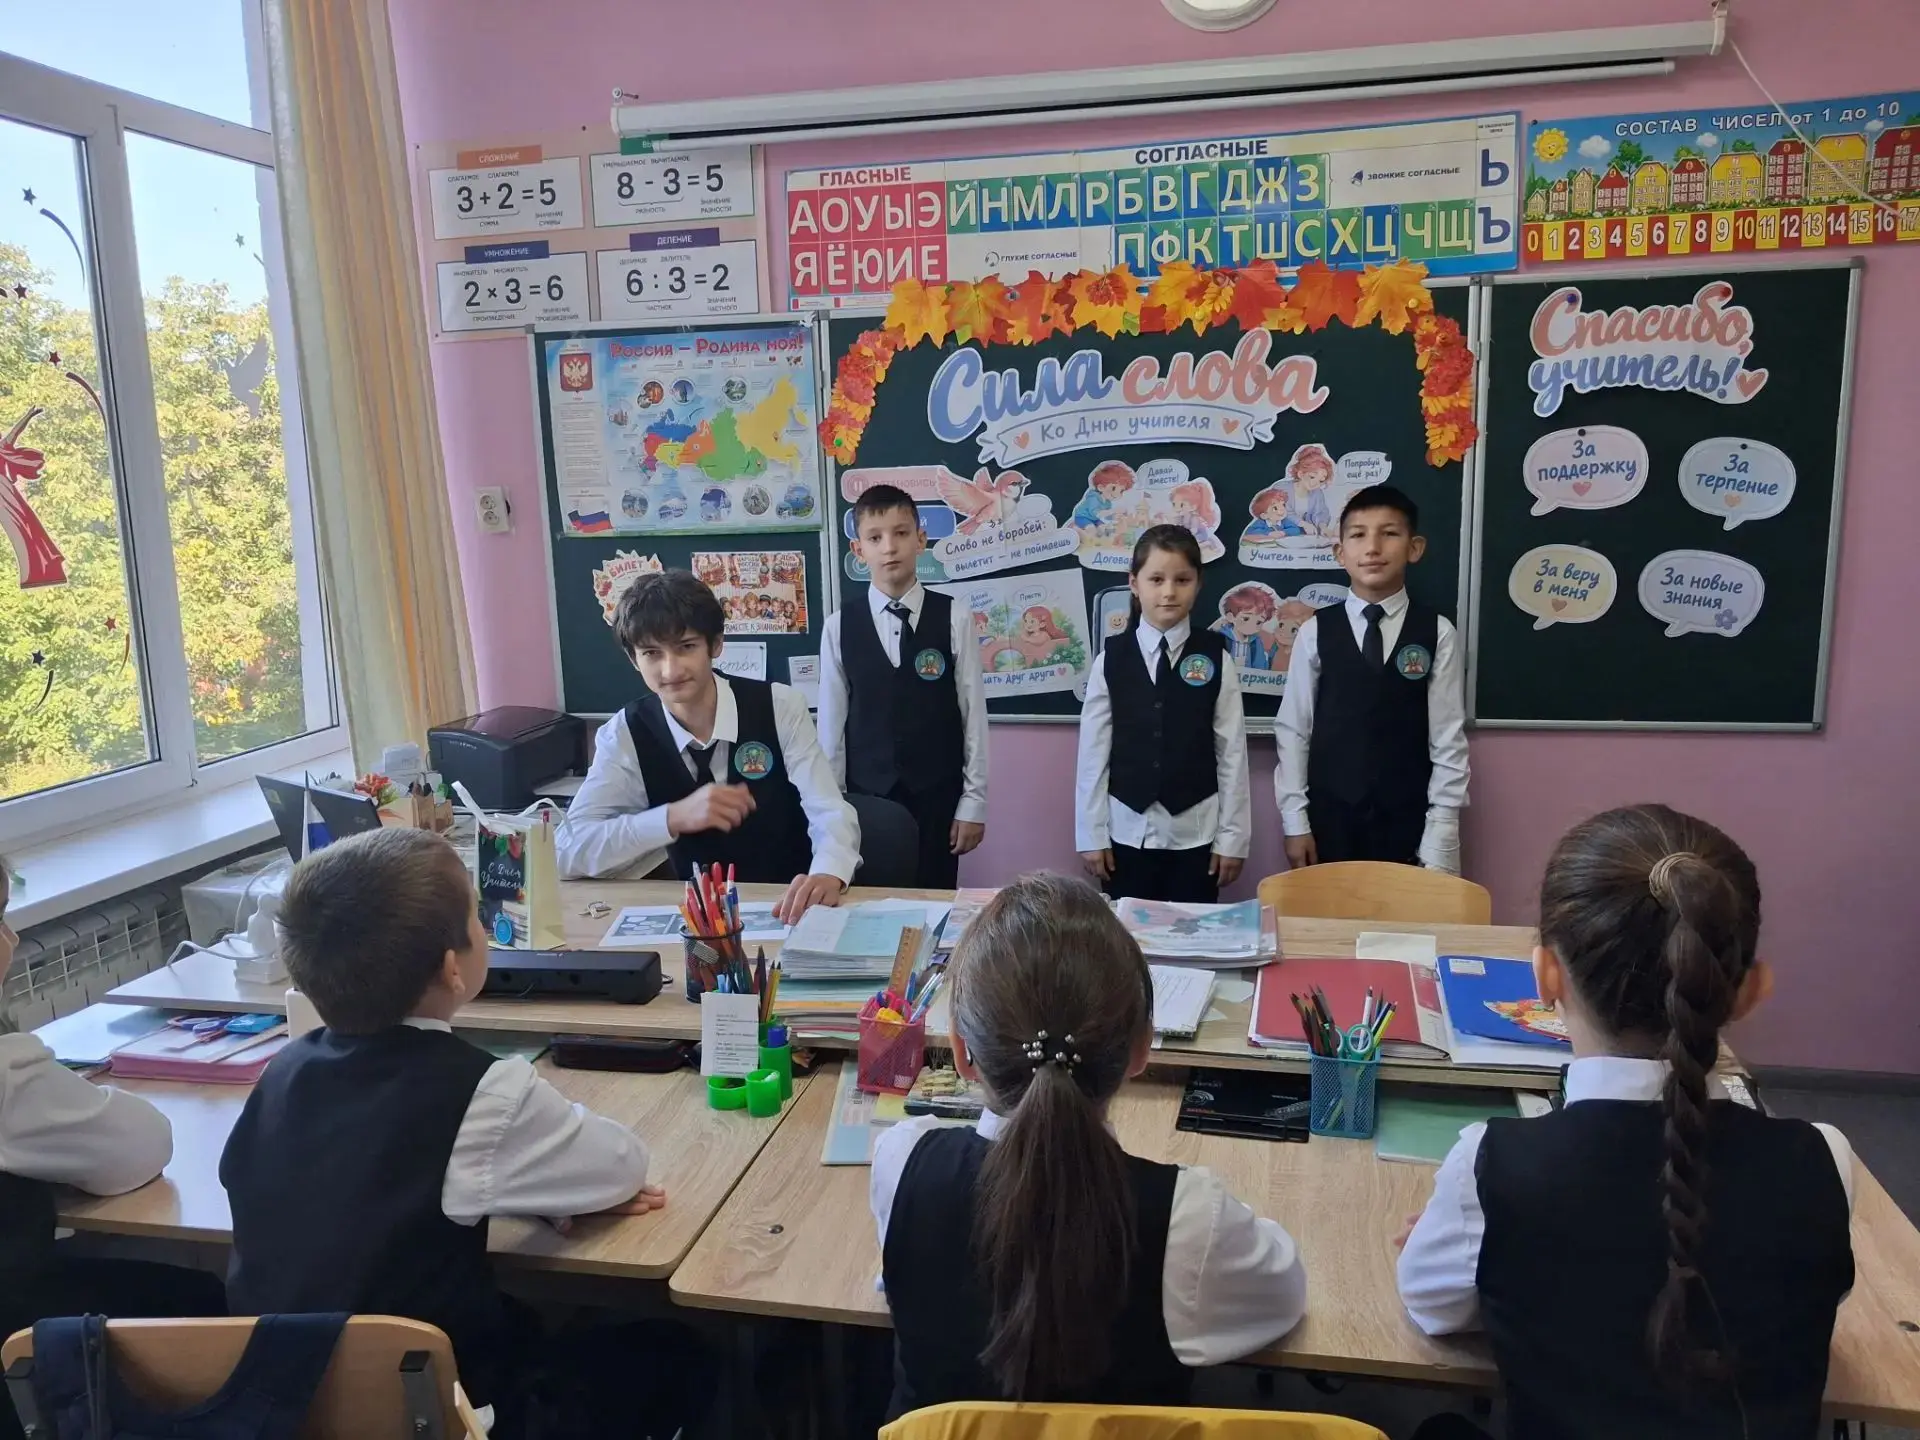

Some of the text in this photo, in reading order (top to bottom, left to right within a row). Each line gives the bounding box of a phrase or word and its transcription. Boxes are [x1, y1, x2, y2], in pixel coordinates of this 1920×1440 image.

[1615, 117, 1697, 137] СОСТАВ
[1711, 112, 1783, 130] ЧИСЕЛ
[1822, 108, 1831, 122] 1
[1877, 101, 1900, 117] 10
[479, 152, 520, 164] СЛОЖЕНИЕ
[1135, 139, 1268, 165] СОГЛАСНЫЕ
[820, 166, 912, 187] ГЛАСНЫЕ
[1367, 166, 1461, 181] ЗВОНКИЕ СОГЛАСНЫЕ
[657, 235, 693, 247] ДЕЛЕНИЕ
[1527, 230, 1539, 252] 0
[1548, 228, 1558, 251] 1
[1568, 227, 1580, 250] 2
[1588, 226, 1602, 249] 3
[1609, 224, 1623, 248] 4
[1630, 223, 1644, 247] 5
[1652, 221, 1665, 245] 6
[1674, 220, 1687, 244] 7
[1694, 219, 1707, 243] 8
[1716, 217, 1730, 242] 9
[1736, 216, 1754, 240] 10
[1759, 214, 1776, 240] 11
[1780, 214, 1800, 238] 12
[1803, 212, 1823, 237] 13
[1827, 211, 1847, 235] 14
[1850, 209, 1870, 235] 15
[1874, 209, 1894, 232] 16
[484, 247, 530, 257] УМНОЖЕНИЕ
[930, 328, 1328, 439] Сила слова
[1530, 354, 1740, 415] учитель!
[1041, 414, 1211, 442] Ко Дню учителя
[1572, 439, 1596, 459] За
[1538, 460, 1637, 482] поддержку
[1724, 454, 1749, 474] За
[1695, 471, 1779, 496] терпение
[945, 538, 978, 555] Слово
[982, 536, 994, 546] не
[955, 540, 1071, 572] вылетит не поймаешь
[1250, 549, 1294, 561] Учитель
[610, 560, 643, 577] БИЛЕТ
[1536, 559, 1600, 588] За веру
[1534, 580, 1589, 602] в меня
[1660, 567, 1743, 594] За новые
[1663, 591, 1723, 610] знания
